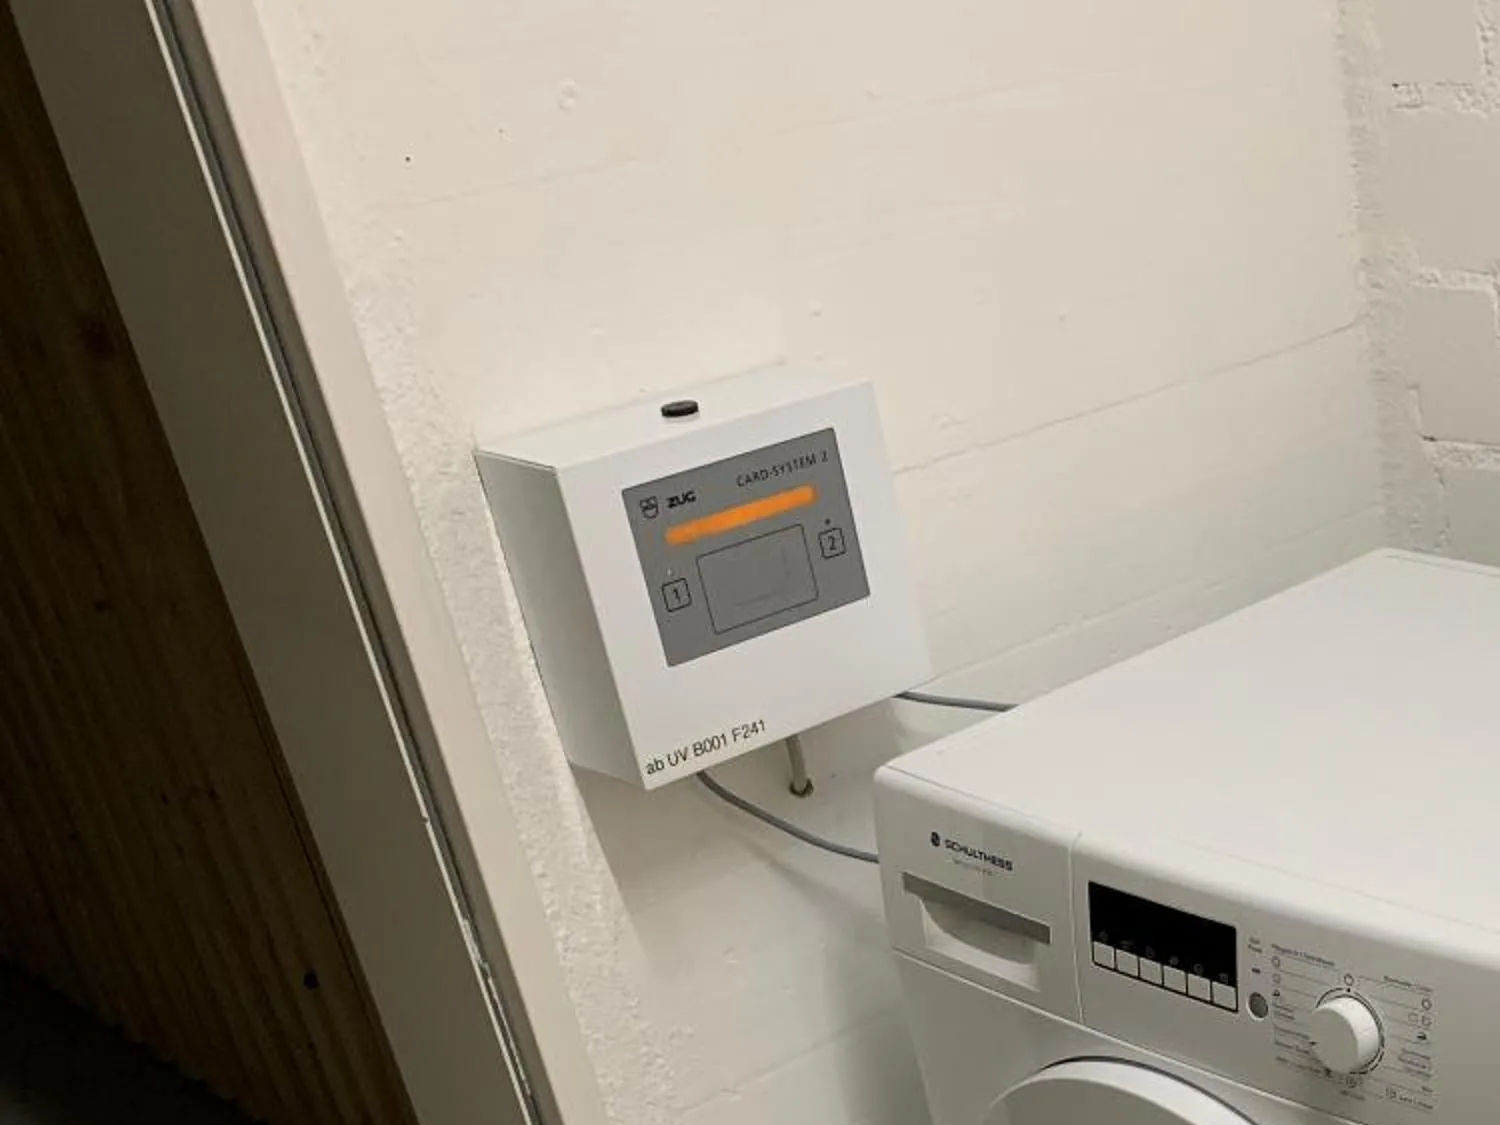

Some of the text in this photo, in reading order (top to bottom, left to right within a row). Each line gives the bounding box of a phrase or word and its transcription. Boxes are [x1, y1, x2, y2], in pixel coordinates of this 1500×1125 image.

[736, 453, 817, 487] CARD-SYSTEM
[666, 491, 697, 509] ZUG
[825, 535, 837, 551] 2
[645, 719, 765, 775] ab UV B001 F241
[944, 839, 1013, 871] SCHULTHESS
